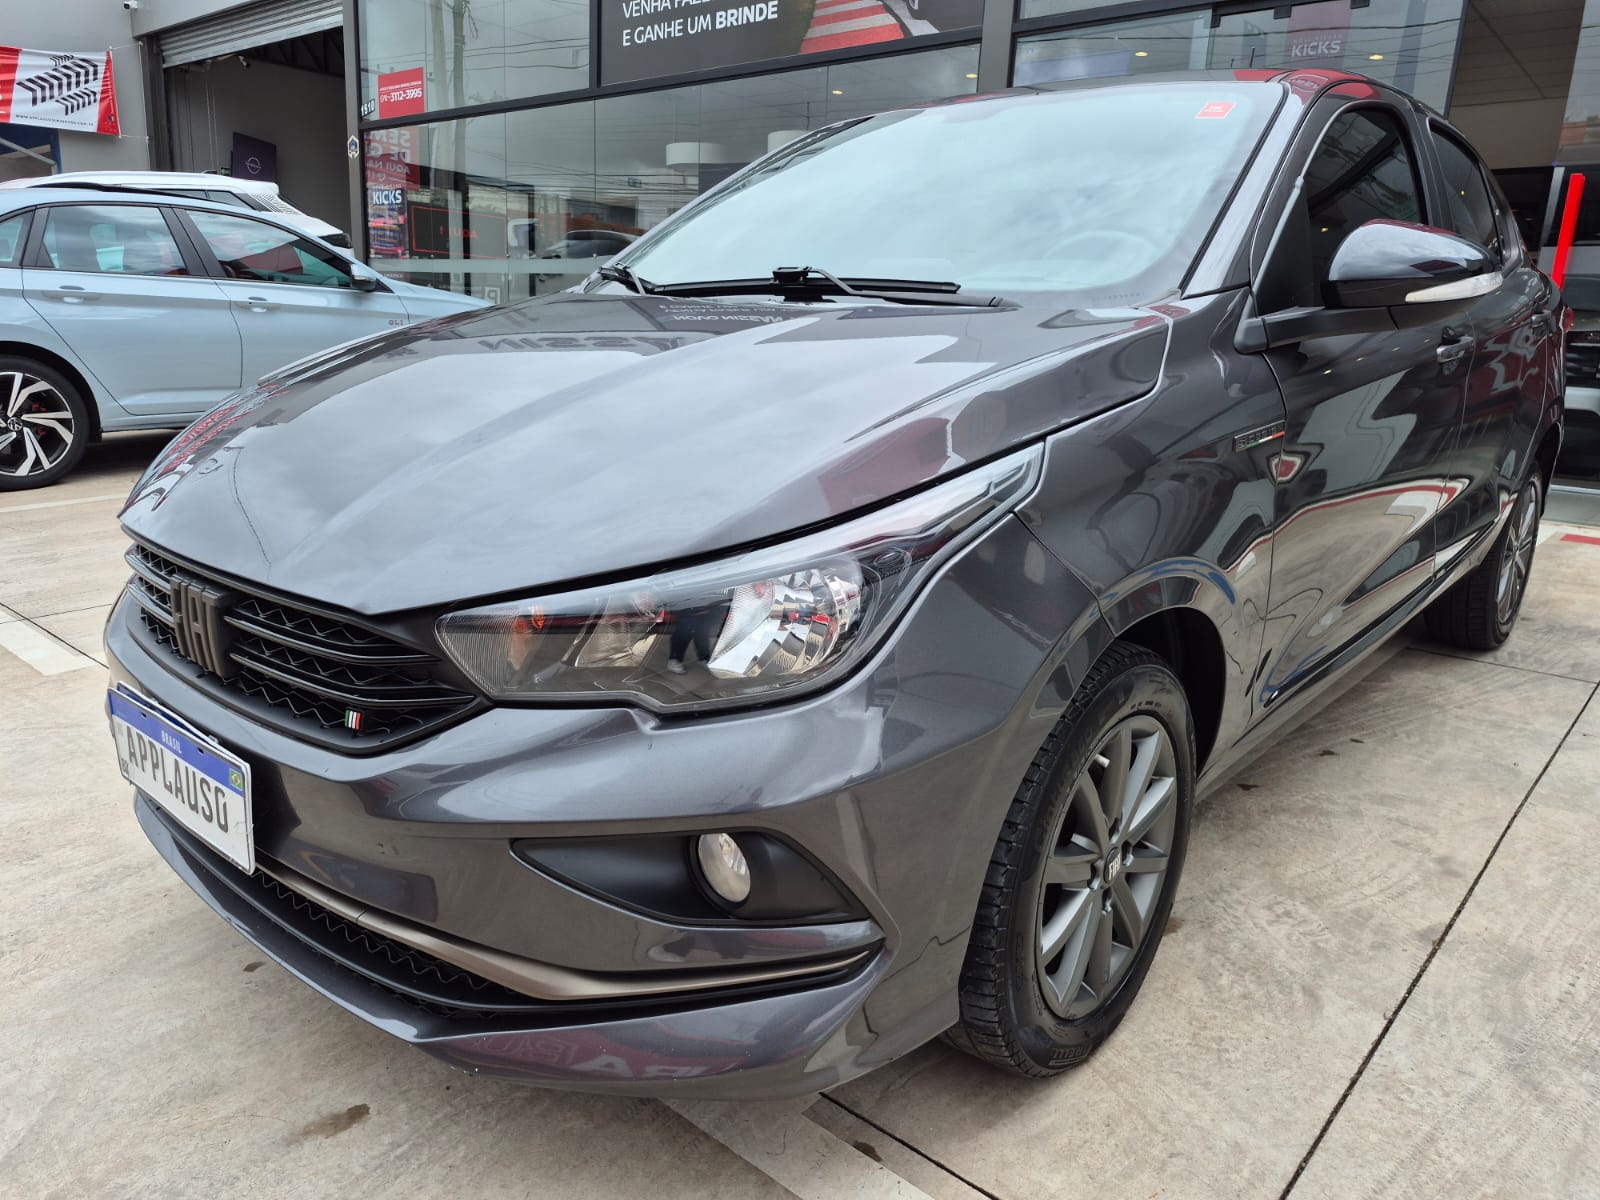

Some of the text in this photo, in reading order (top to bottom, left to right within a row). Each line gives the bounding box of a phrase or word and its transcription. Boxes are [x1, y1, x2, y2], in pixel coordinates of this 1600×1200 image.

[622, 0, 671, 18] VENHA
[622, 1, 779, 46] E GANHE UM BRINDE
[1292, 40, 1342, 57] KICKS
[373, 190, 403, 205] KICKS
[170, 575, 224, 677] FIAT
[161, 730, 182, 754] BRASIL
